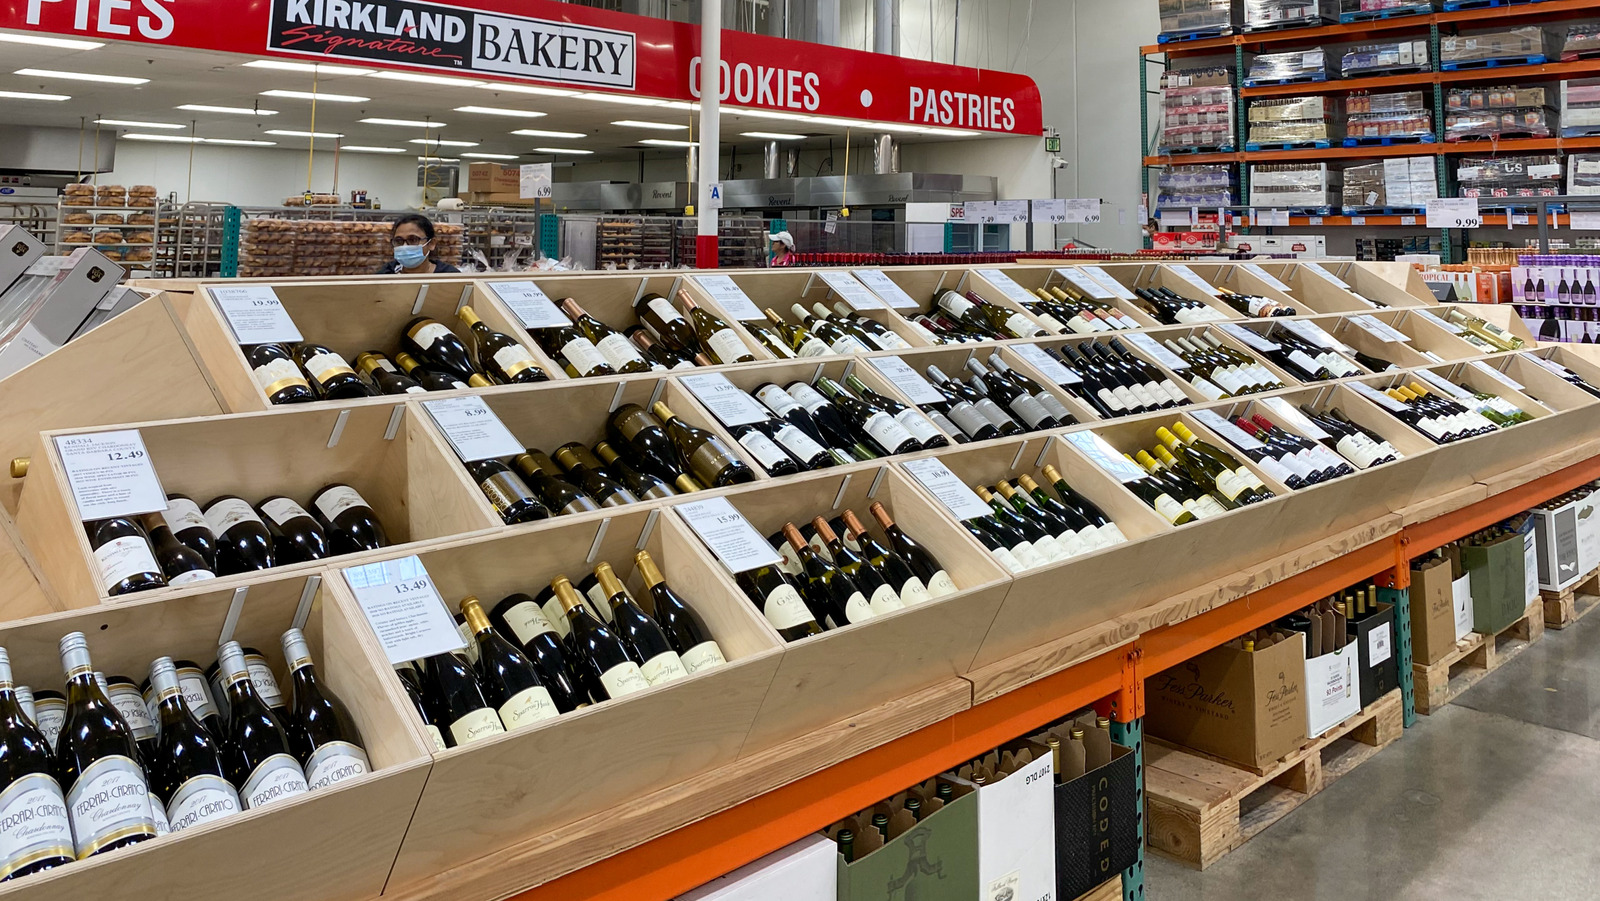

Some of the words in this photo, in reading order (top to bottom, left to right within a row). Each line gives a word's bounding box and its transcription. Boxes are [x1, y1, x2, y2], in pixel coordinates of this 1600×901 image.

[286, 0, 467, 43] KIRKLAND
[281, 25, 463, 60] Signature
[476, 23, 629, 76] BAKERY
[909, 86, 1016, 131] PASTRIES
[537, 186, 551, 197] 6.99
[711, 186, 720, 199] A
[1012, 214, 1027, 222] 6.99
[1050, 214, 1065, 222] 9.99
[1084, 214, 1099, 222] 6.99
[1455, 218, 1478, 227] 9.99
[464, 408, 487, 416] 8.99
[107, 450, 144, 460] 12.49
[716, 513, 740, 524] 15.99
[393, 579, 428, 593] 13.49
[1156, 675, 1185, 694] Fess
[1183, 683, 1233, 710] Parker
[100, 775, 121, 787] 2017
[1025, 771, 1038, 785] DLG
[90, 801, 142, 822] Chardonnay
[13, 823, 65, 840] Chardonnay
